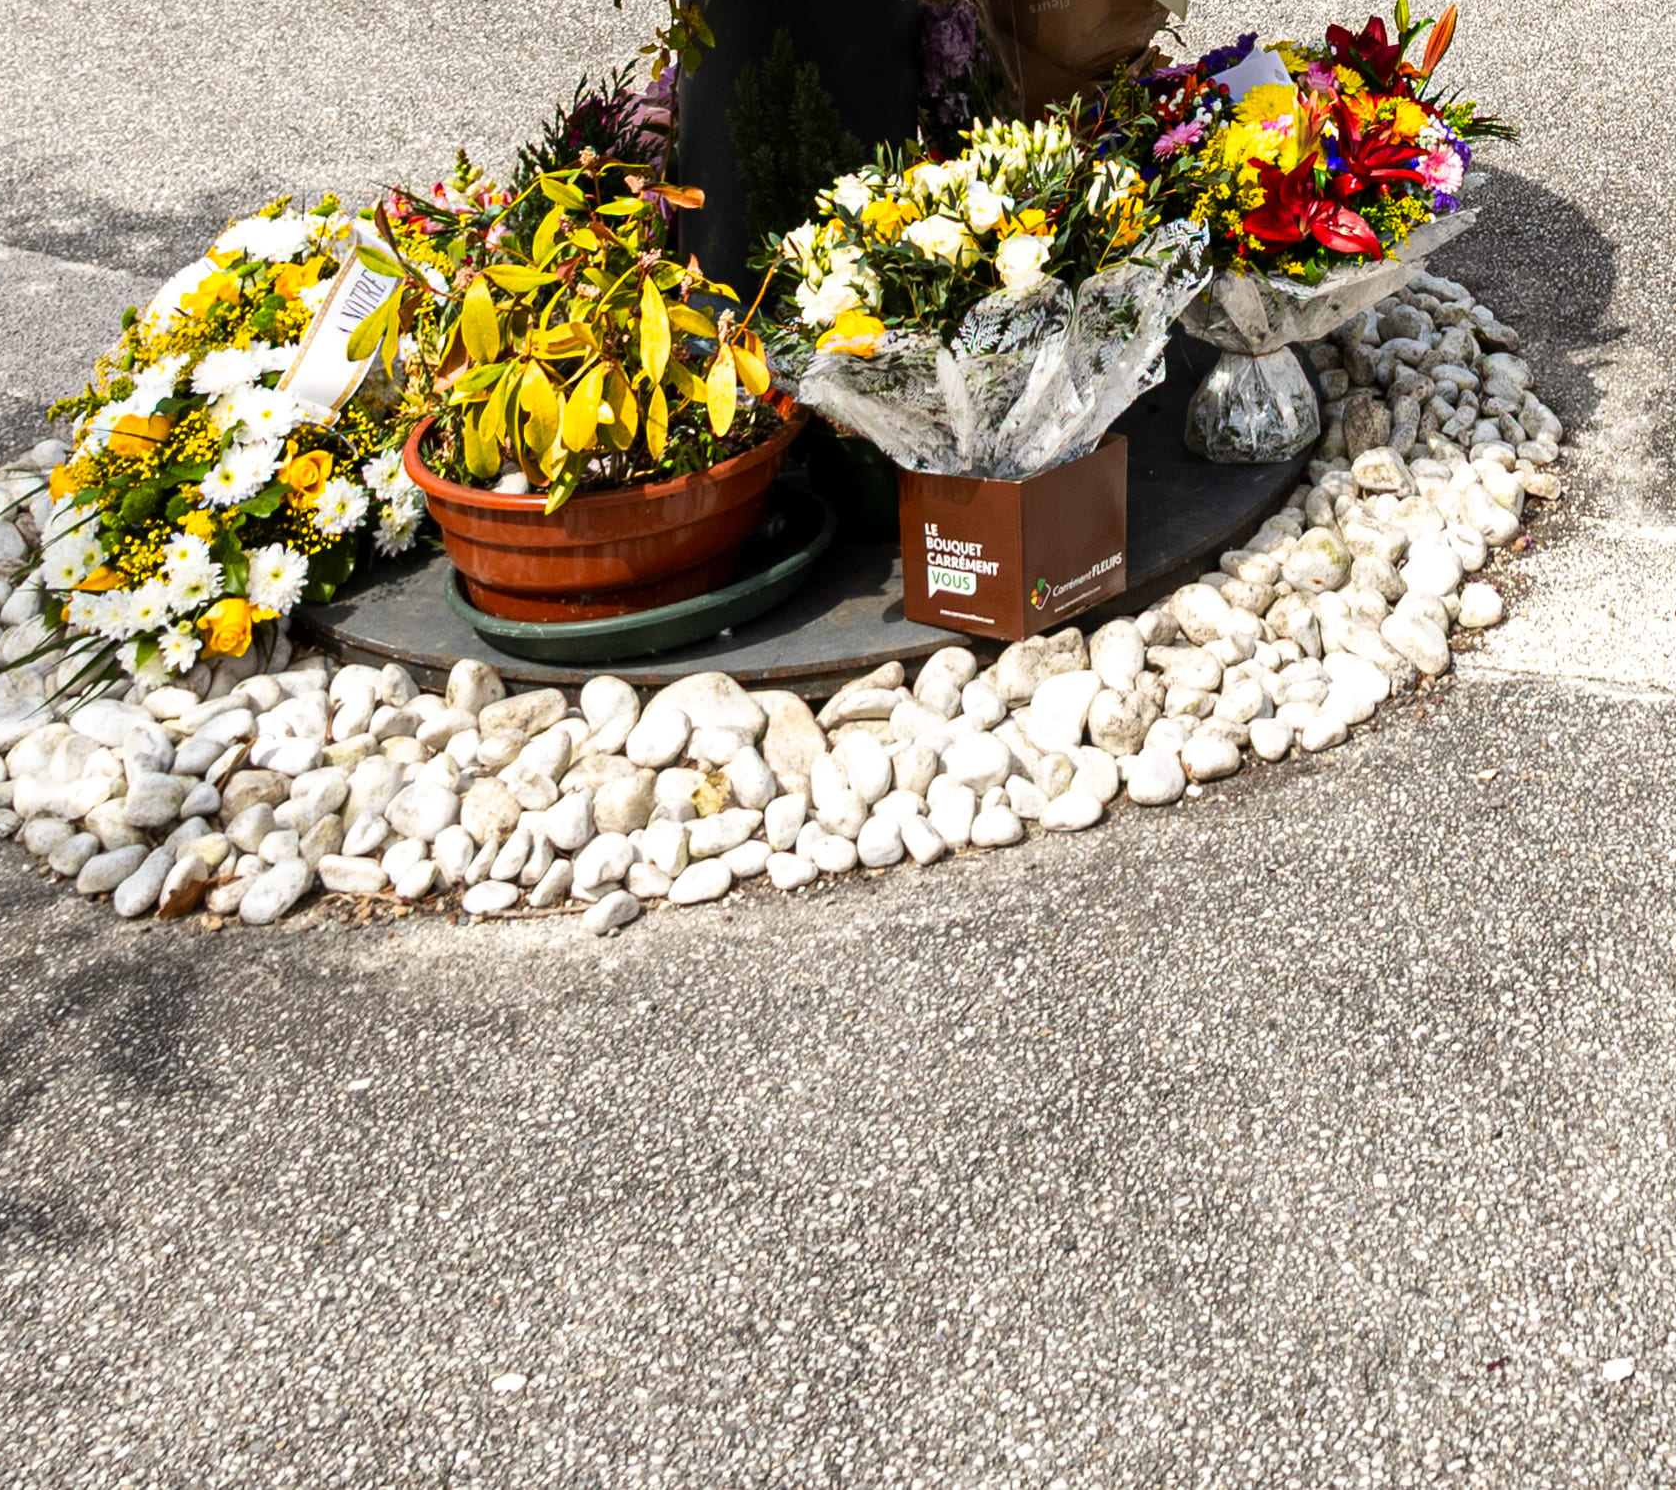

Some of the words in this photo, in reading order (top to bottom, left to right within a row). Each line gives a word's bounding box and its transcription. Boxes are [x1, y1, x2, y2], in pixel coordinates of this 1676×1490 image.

[924, 522, 939, 537] LE
[925, 536, 983, 558] BOUQUET
[926, 552, 1000, 576] CARRÉMENT
[931, 570, 971, 591] VOUS
